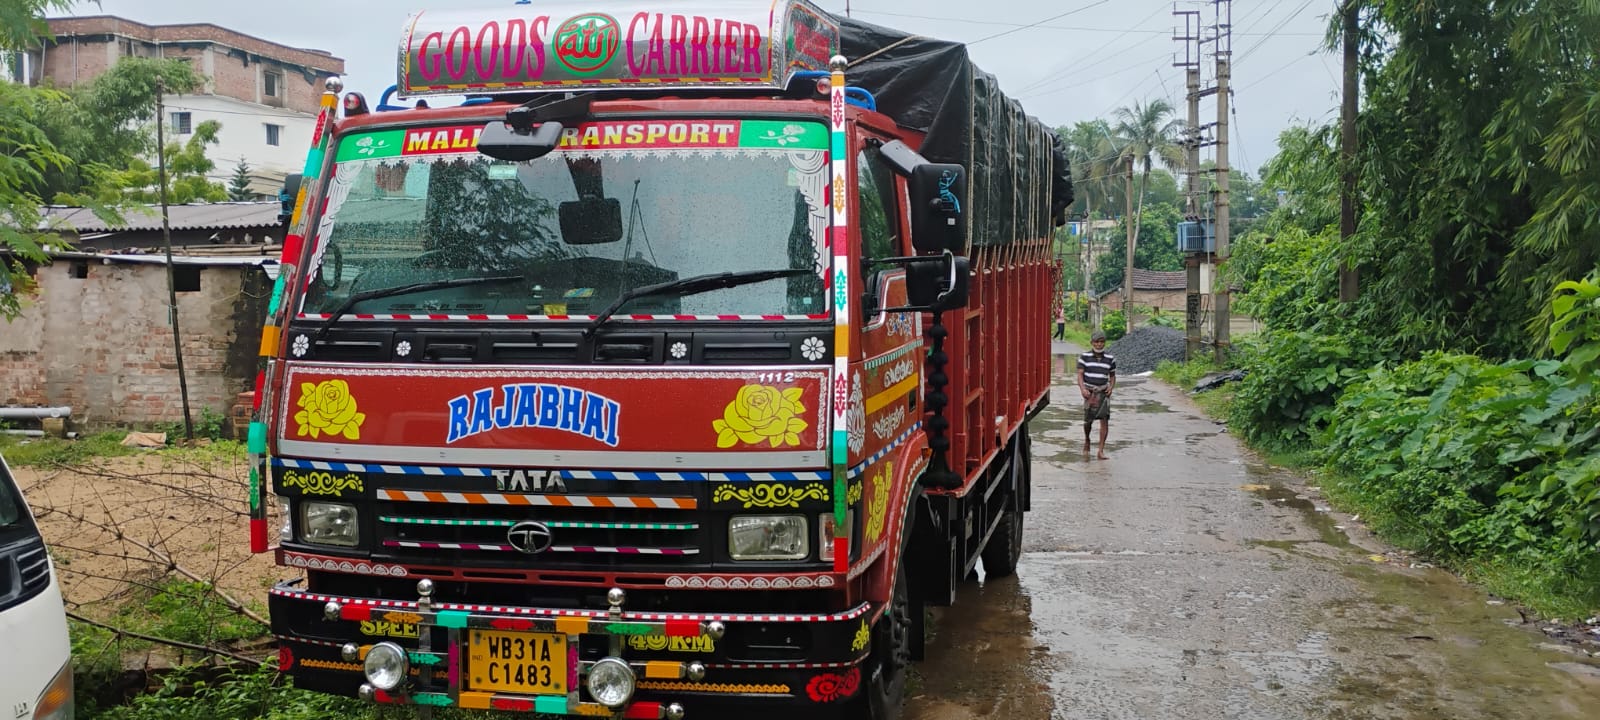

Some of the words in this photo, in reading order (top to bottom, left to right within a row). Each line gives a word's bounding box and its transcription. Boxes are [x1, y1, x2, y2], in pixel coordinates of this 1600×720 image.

[417, 15, 550, 81] GOODS
[626, 12, 763, 76] CARRIER
[559, 124, 737, 147] RANSPORT
[758, 372, 794, 384] 1112
[446, 382, 621, 447] RAJABHAI
[491, 469, 568, 493] TATA
[360, 619, 420, 638] SPEE
[488, 636, 551, 662] WB31A
[488, 662, 551, 687] C1483
